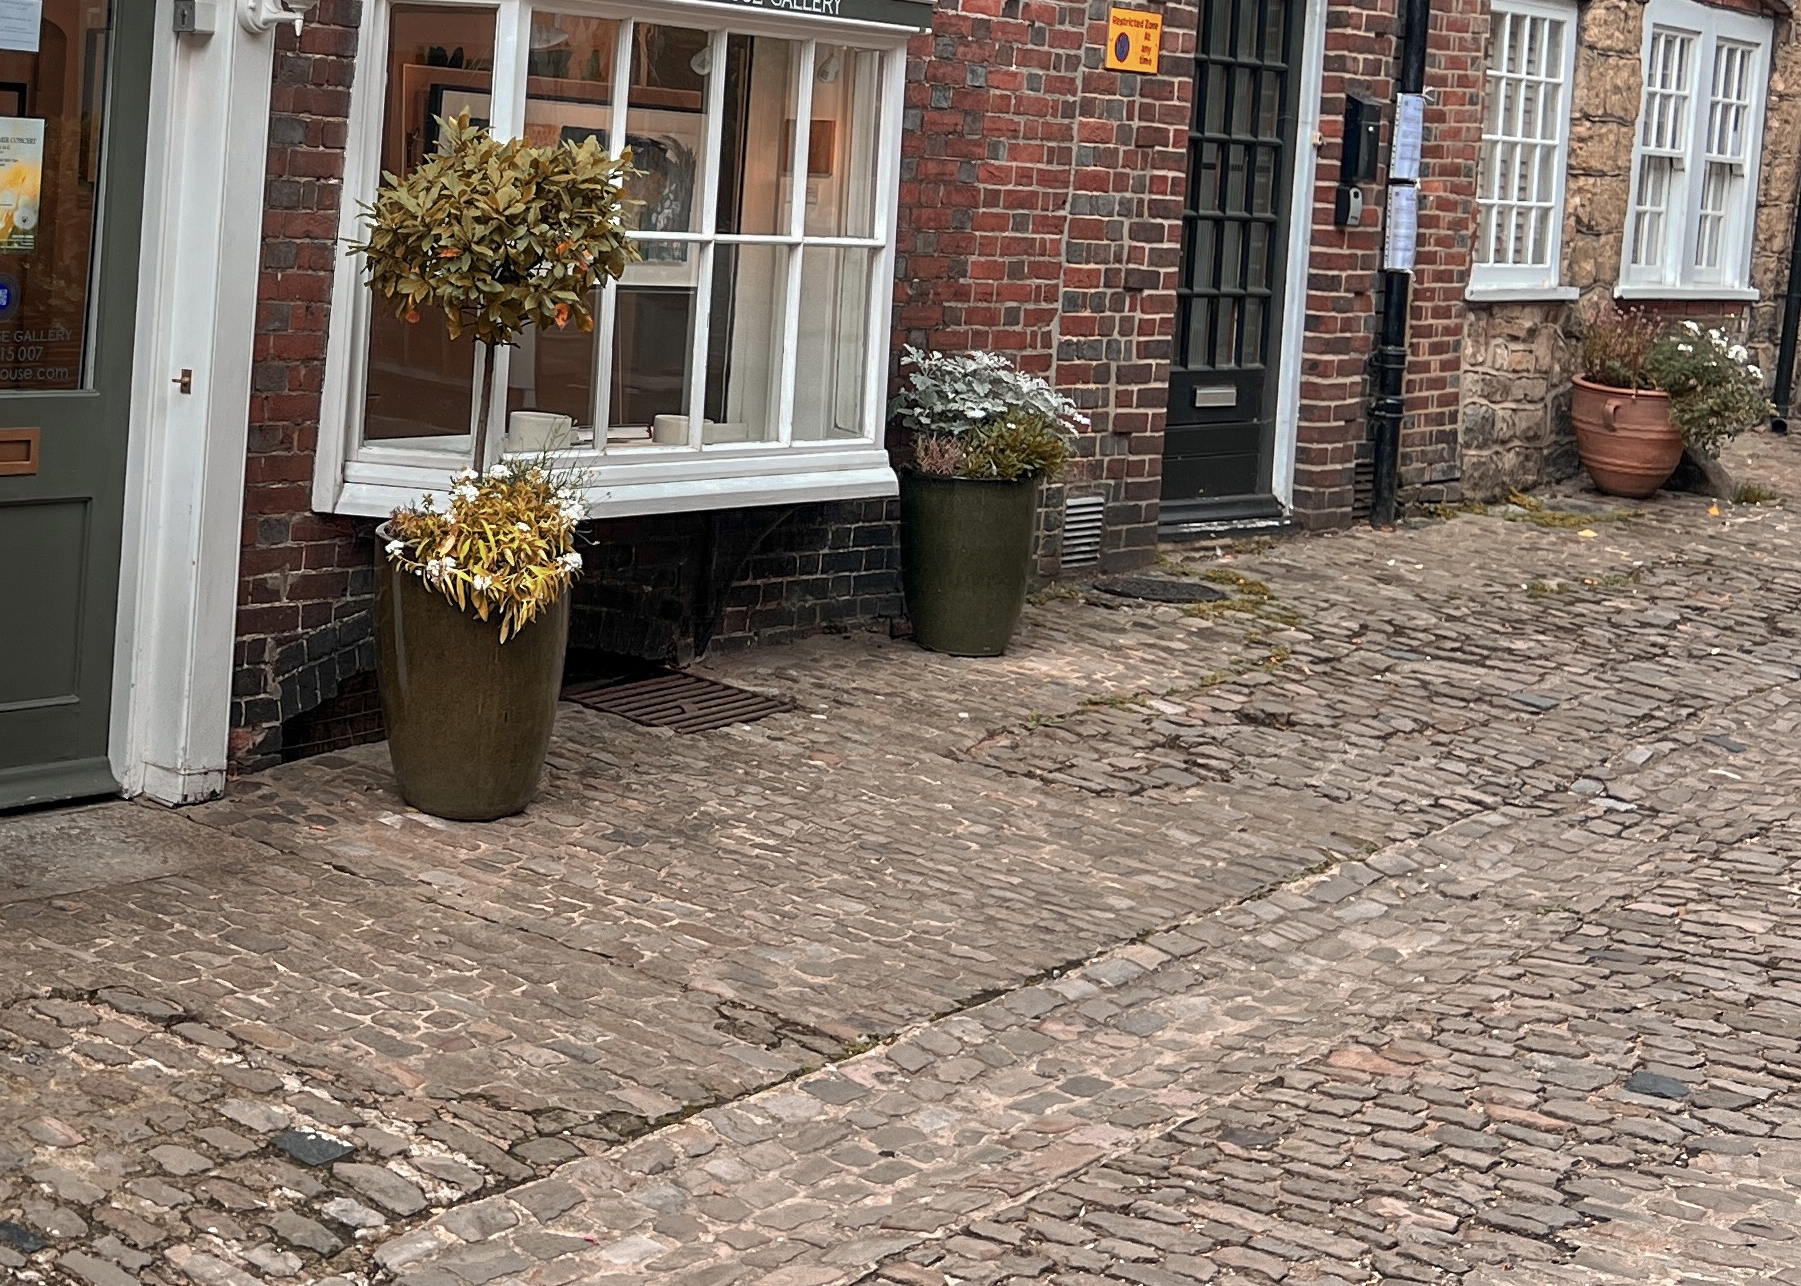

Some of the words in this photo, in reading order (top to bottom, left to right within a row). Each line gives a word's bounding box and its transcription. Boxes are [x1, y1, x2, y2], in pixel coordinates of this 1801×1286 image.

[1112, 15, 1144, 29] Restricted
[14, 329, 73, 342] GALLERY
[18, 346, 44, 361] 007
